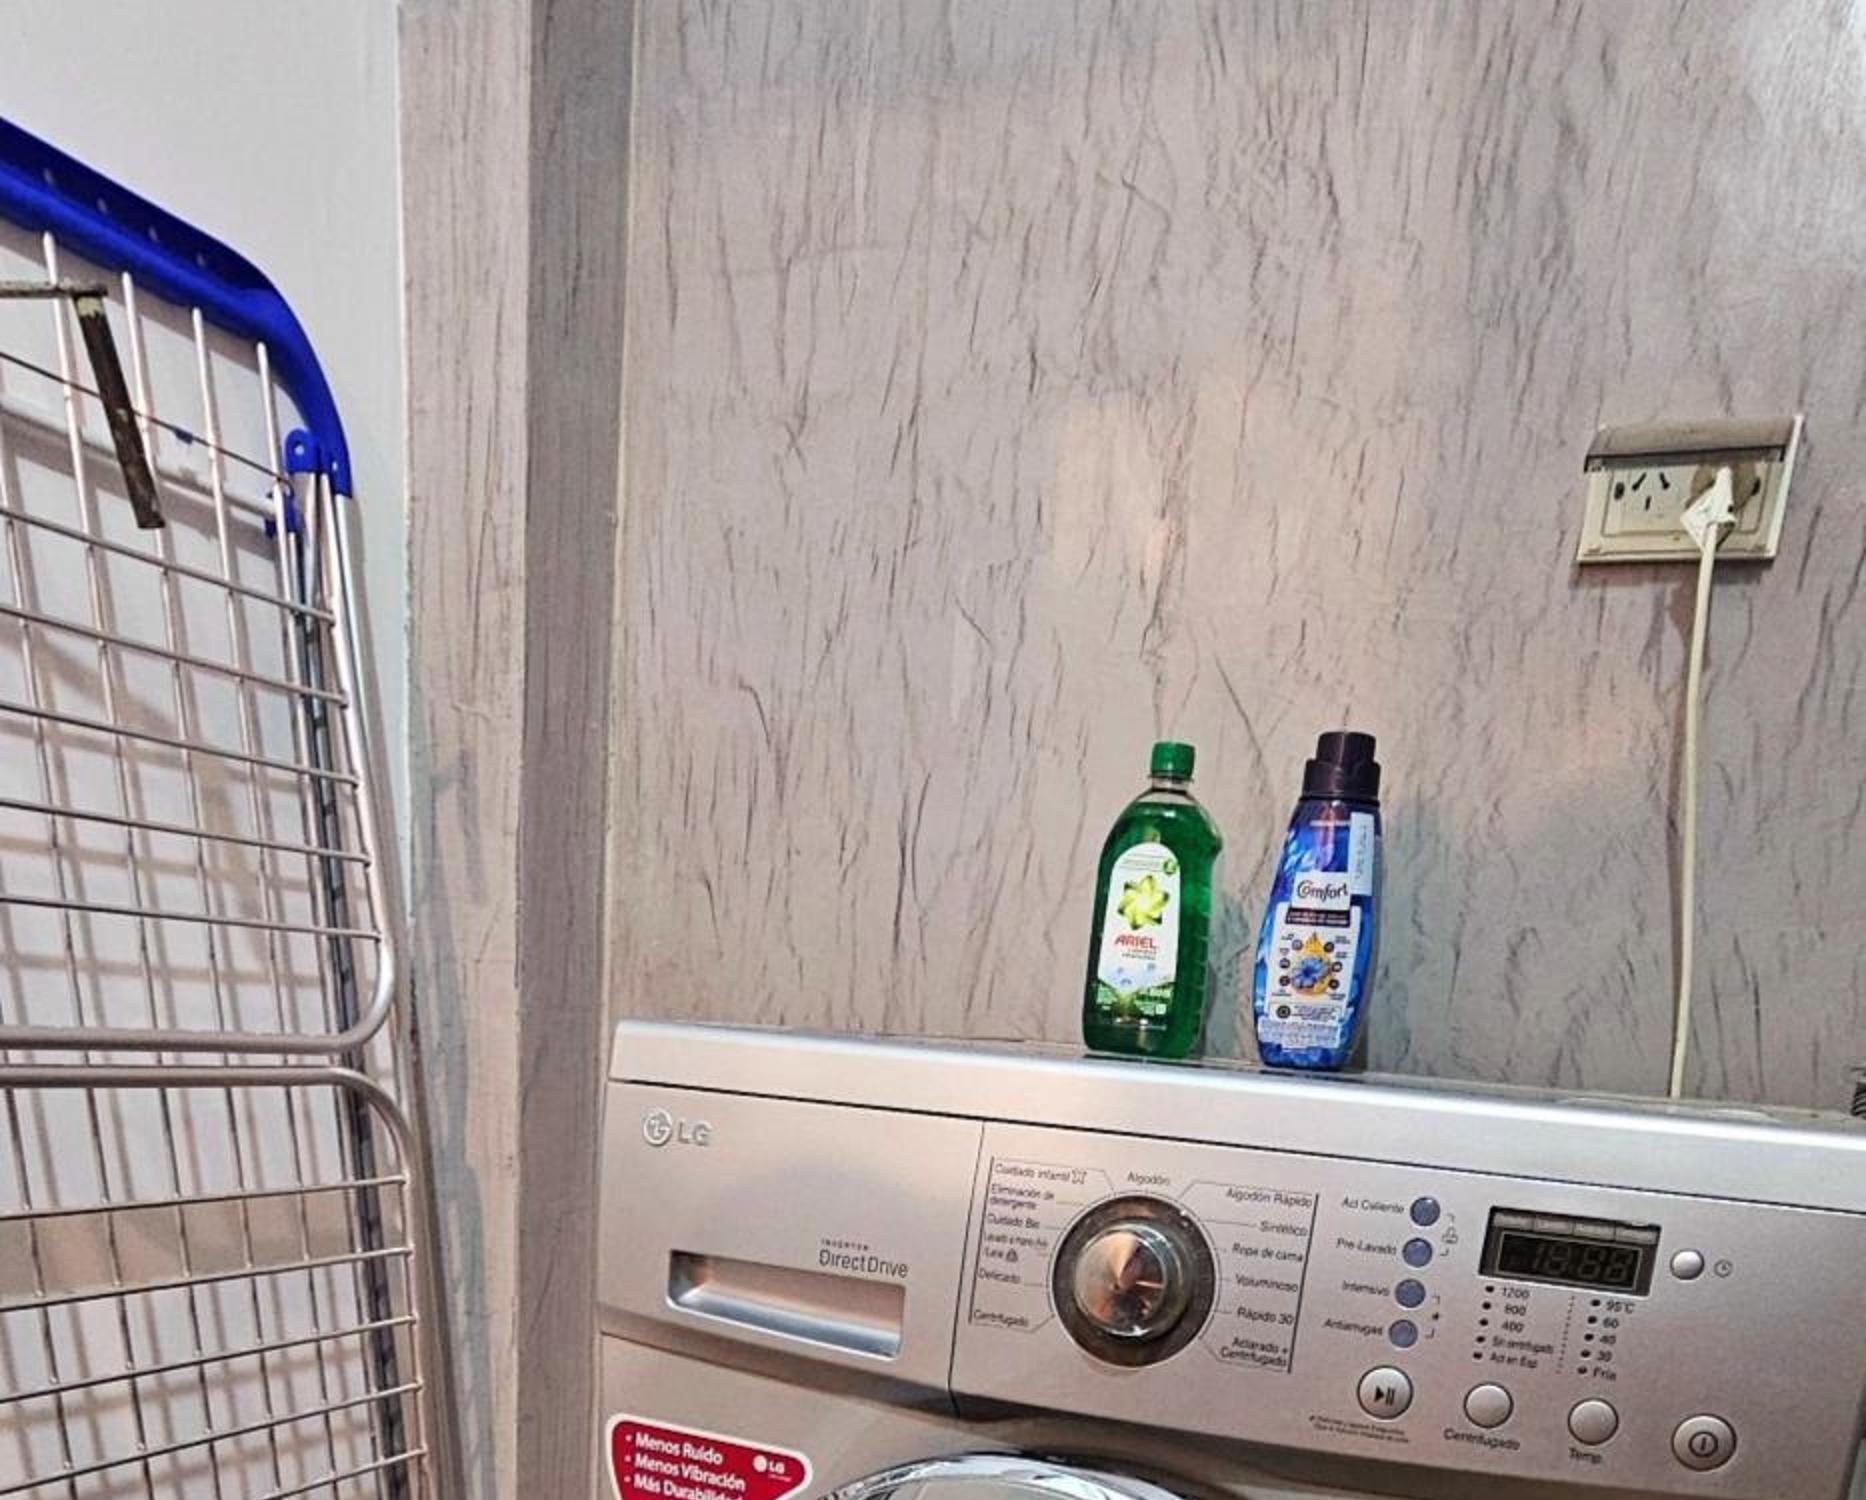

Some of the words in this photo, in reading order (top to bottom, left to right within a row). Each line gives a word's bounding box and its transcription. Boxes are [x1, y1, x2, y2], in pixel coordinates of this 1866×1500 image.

[1297, 880, 1348, 902] Comfort
[1115, 934, 1159, 949] ARIEL
[678, 1118, 713, 1147] LG
[1127, 1171, 1170, 1186] Algodón
[1226, 1188, 1271, 1205] Algodón
[1361, 1199, 1404, 1214] Caliente
[1232, 1243, 1259, 1259] Ropa
[1260, 1248, 1274, 1260] de
[1275, 1251, 1303, 1263] cama
[978, 1268, 1021, 1284] Delicado
[1236, 1274, 1299, 1293] Voluminoso
[1342, 1280, 1390, 1297] Intensivo
[1501, 1287, 1530, 1300] 1200
[974, 1309, 1029, 1327] Centrifugado
[1501, 1320, 1525, 1333] 400
[1602, 1317, 1620, 1330] 60
[1232, 1337, 1279, 1353] Aclarado
[1221, 1347, 1288, 1367] Centrifugado
[635, 1432, 681, 1455] Menos
[1443, 1427, 1521, 1451] Centrifugado
[635, 1452, 680, 1476] Menos
[681, 1461, 746, 1492] Vibración
[768, 1462, 785, 1474] LG
[634, 1474, 661, 1493] Más
